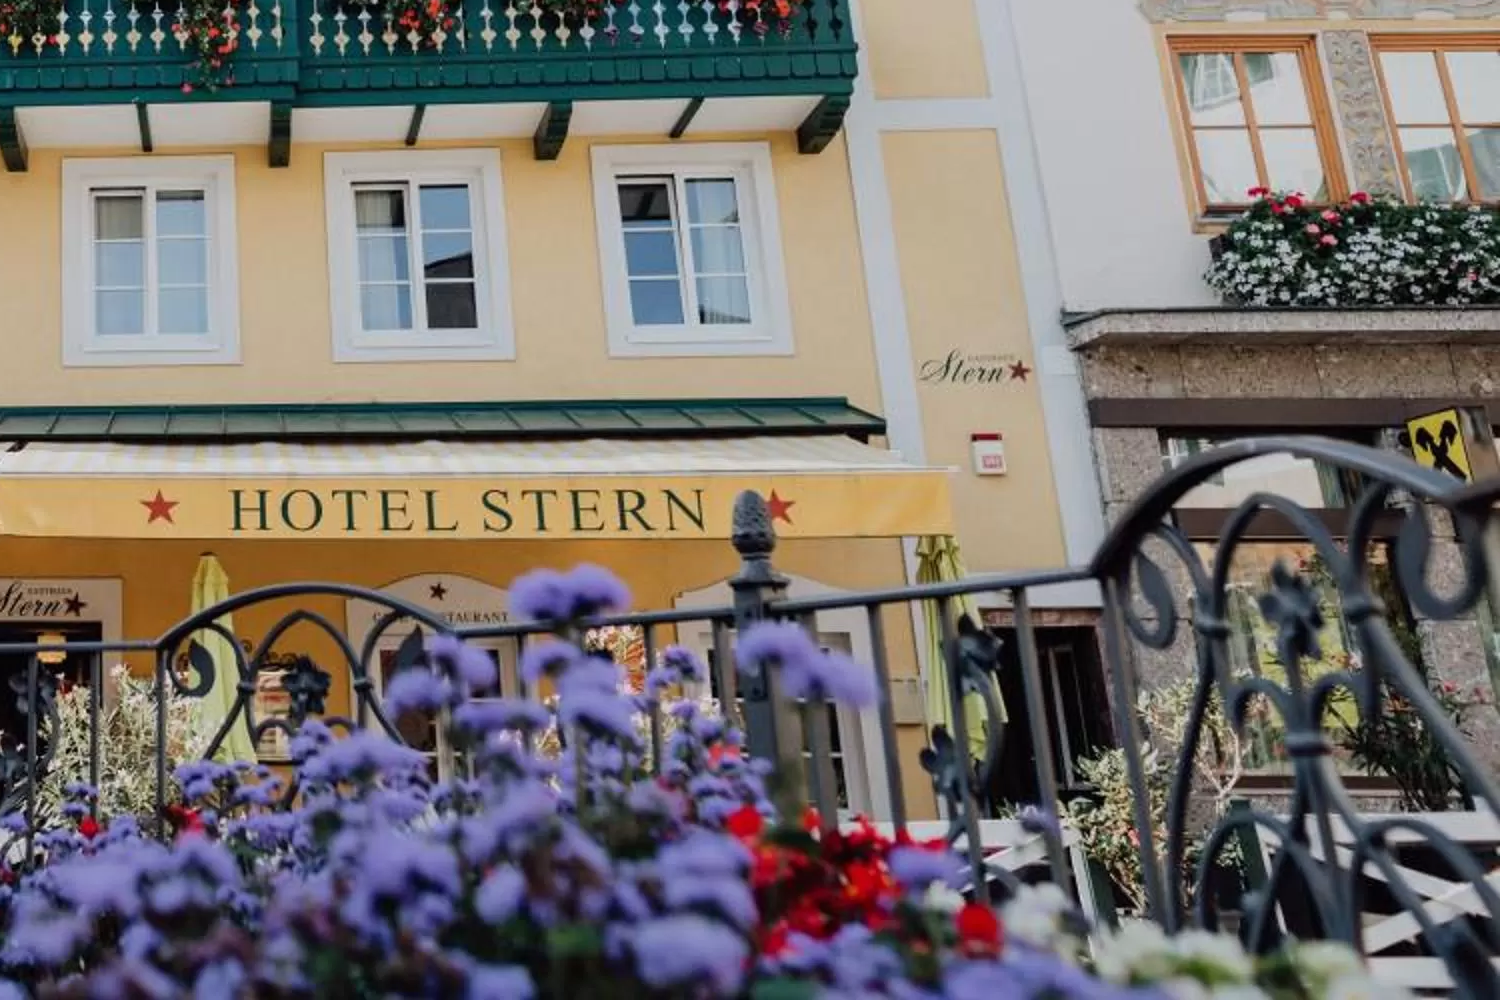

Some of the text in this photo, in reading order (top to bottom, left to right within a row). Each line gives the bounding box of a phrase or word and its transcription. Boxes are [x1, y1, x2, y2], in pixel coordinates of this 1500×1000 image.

[919, 347, 1003, 384] Stern
[228, 488, 707, 533] HOTEL STERN
